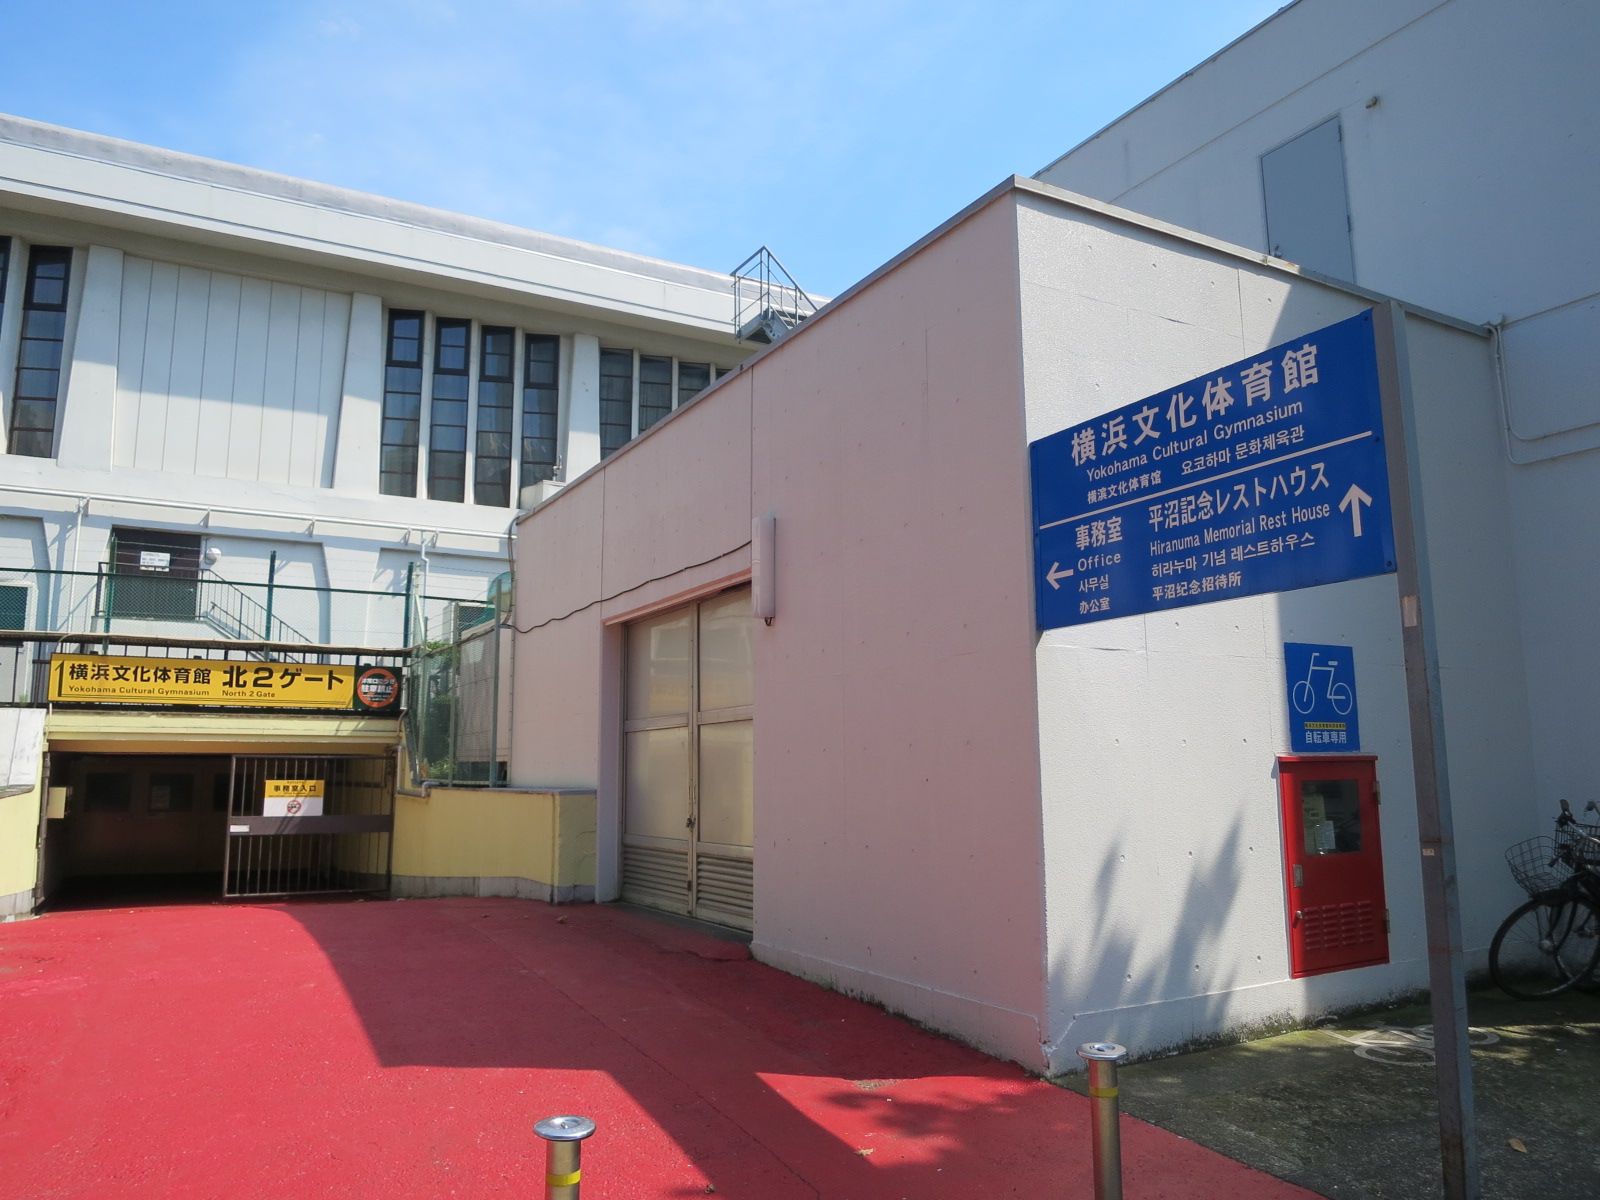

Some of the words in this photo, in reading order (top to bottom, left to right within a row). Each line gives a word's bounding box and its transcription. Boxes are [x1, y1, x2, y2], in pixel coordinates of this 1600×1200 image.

[1072, 343, 1319, 466] 横浜文化体育館
[1086, 452, 1148, 482] Yokohama
[1152, 430, 1208, 460] Cultural
[1214, 402, 1303, 440] Gymnasium
[1181, 447, 1231, 476] 요코하마
[1235, 425, 1305, 459] 문화체육관
[1149, 462, 1330, 533] 平沼記念レストハウス
[1075, 516, 1123, 551] 事務室
[1150, 536, 1200, 557] Hiranuma
[1204, 519, 1255, 545] Memorial
[1260, 512, 1287, 531] Rest
[1292, 502, 1330, 523] House
[1077, 554, 1121, 572] Office
[1151, 556, 1197, 578] 히라누마
[1202, 548, 1226, 568] 기념
[1231, 531, 1316, 562] 레스트하우스
[1079, 573, 1109, 593] 사무실
[1152, 571, 1242, 601] 平沼纪念招待所
[1079, 598, 1111, 615] 办公室
[69, 663, 211, 685] 横浜文化体育館
[222, 665, 344, 691] 北2ゲート
[69, 685, 116, 694] Yokohama
[119, 686, 154, 695] Cultural
[158, 687, 210, 697] Gymnasium
[222, 690, 247, 698] North
[1305, 730, 1347, 744] 自転車専用
